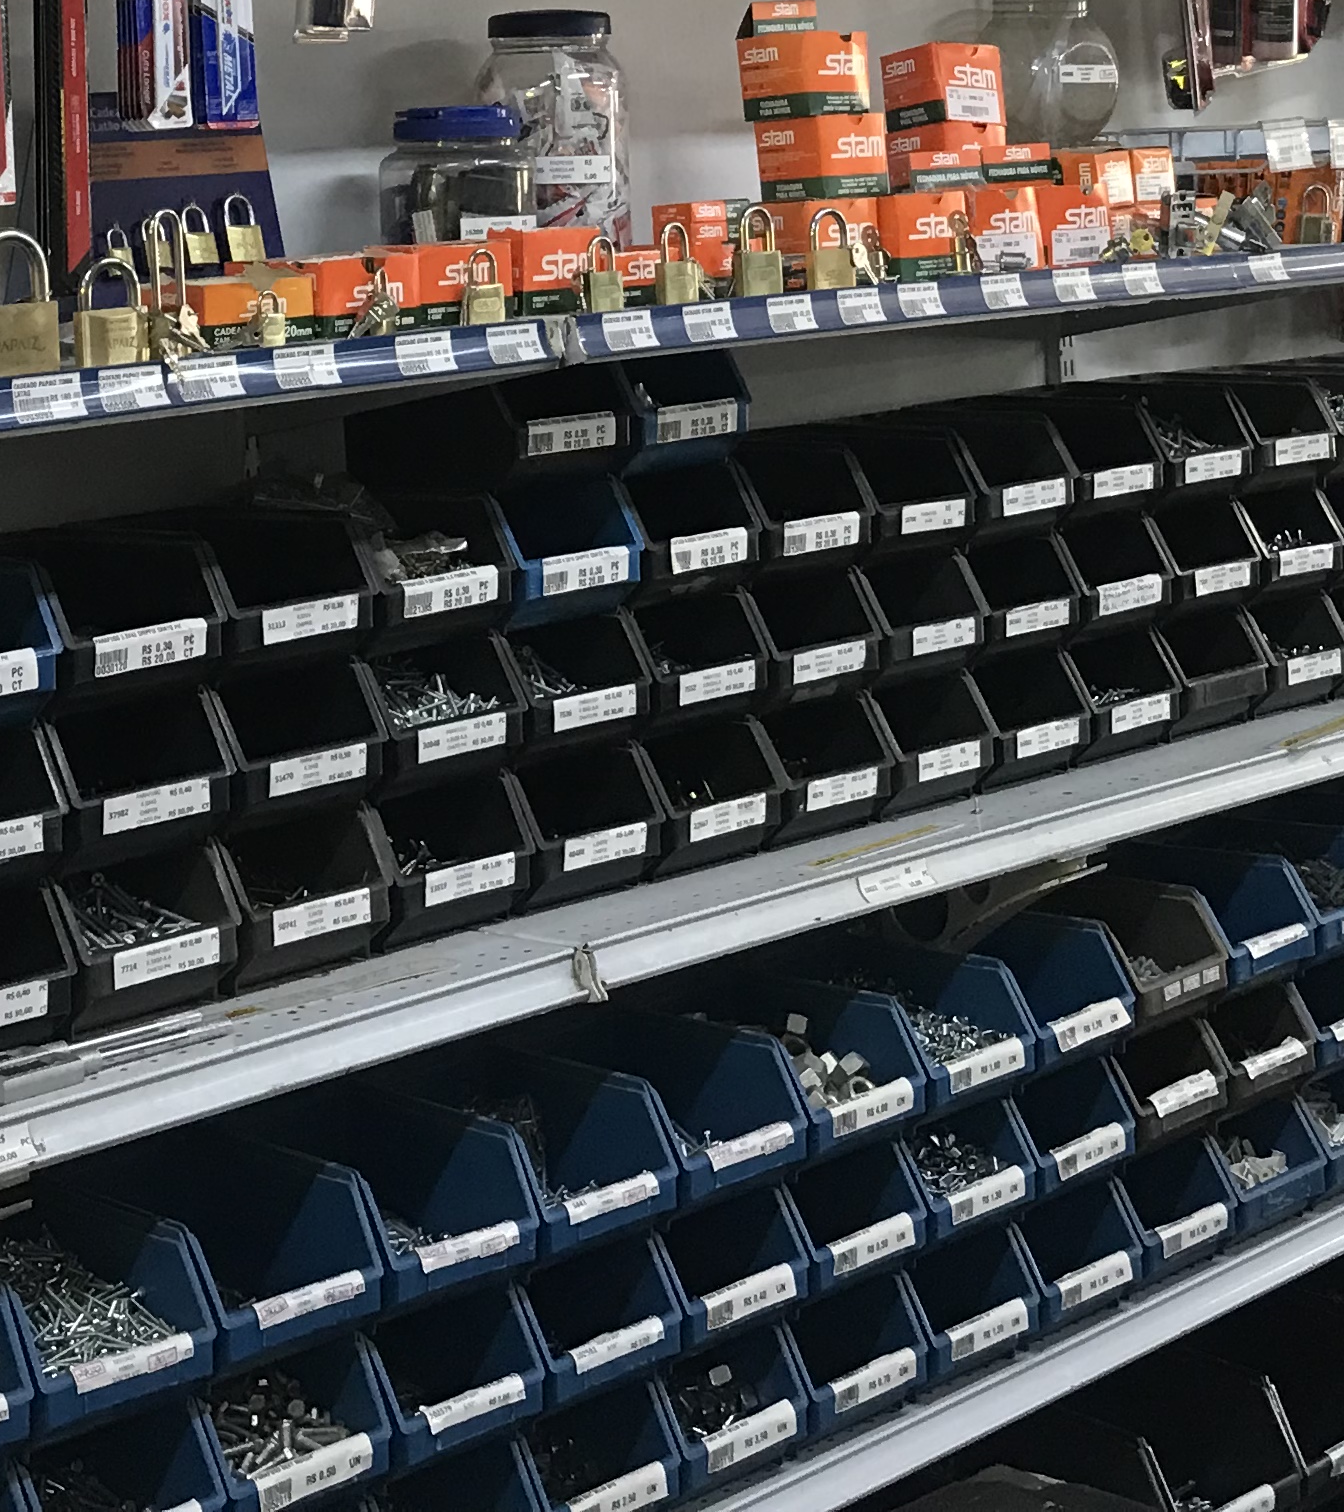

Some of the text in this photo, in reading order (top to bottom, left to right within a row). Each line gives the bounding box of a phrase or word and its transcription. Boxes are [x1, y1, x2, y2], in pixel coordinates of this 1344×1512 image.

[771, 3, 799, 17] stam
[741, 47, 779, 65] stam
[884, 58, 916, 79] stam
[948, 63, 997, 90] stam
[759, 130, 795, 147] stam
[830, 133, 883, 159] stam
[888, 136, 920, 155] stam
[930, 151, 959, 167] stam
[1003, 146, 1031, 161] stam
[696, 204, 722, 218] stam
[1057, 204, 1108, 229] stam
[982, 208, 1037, 233] stam
[696, 224, 723, 239] stam
